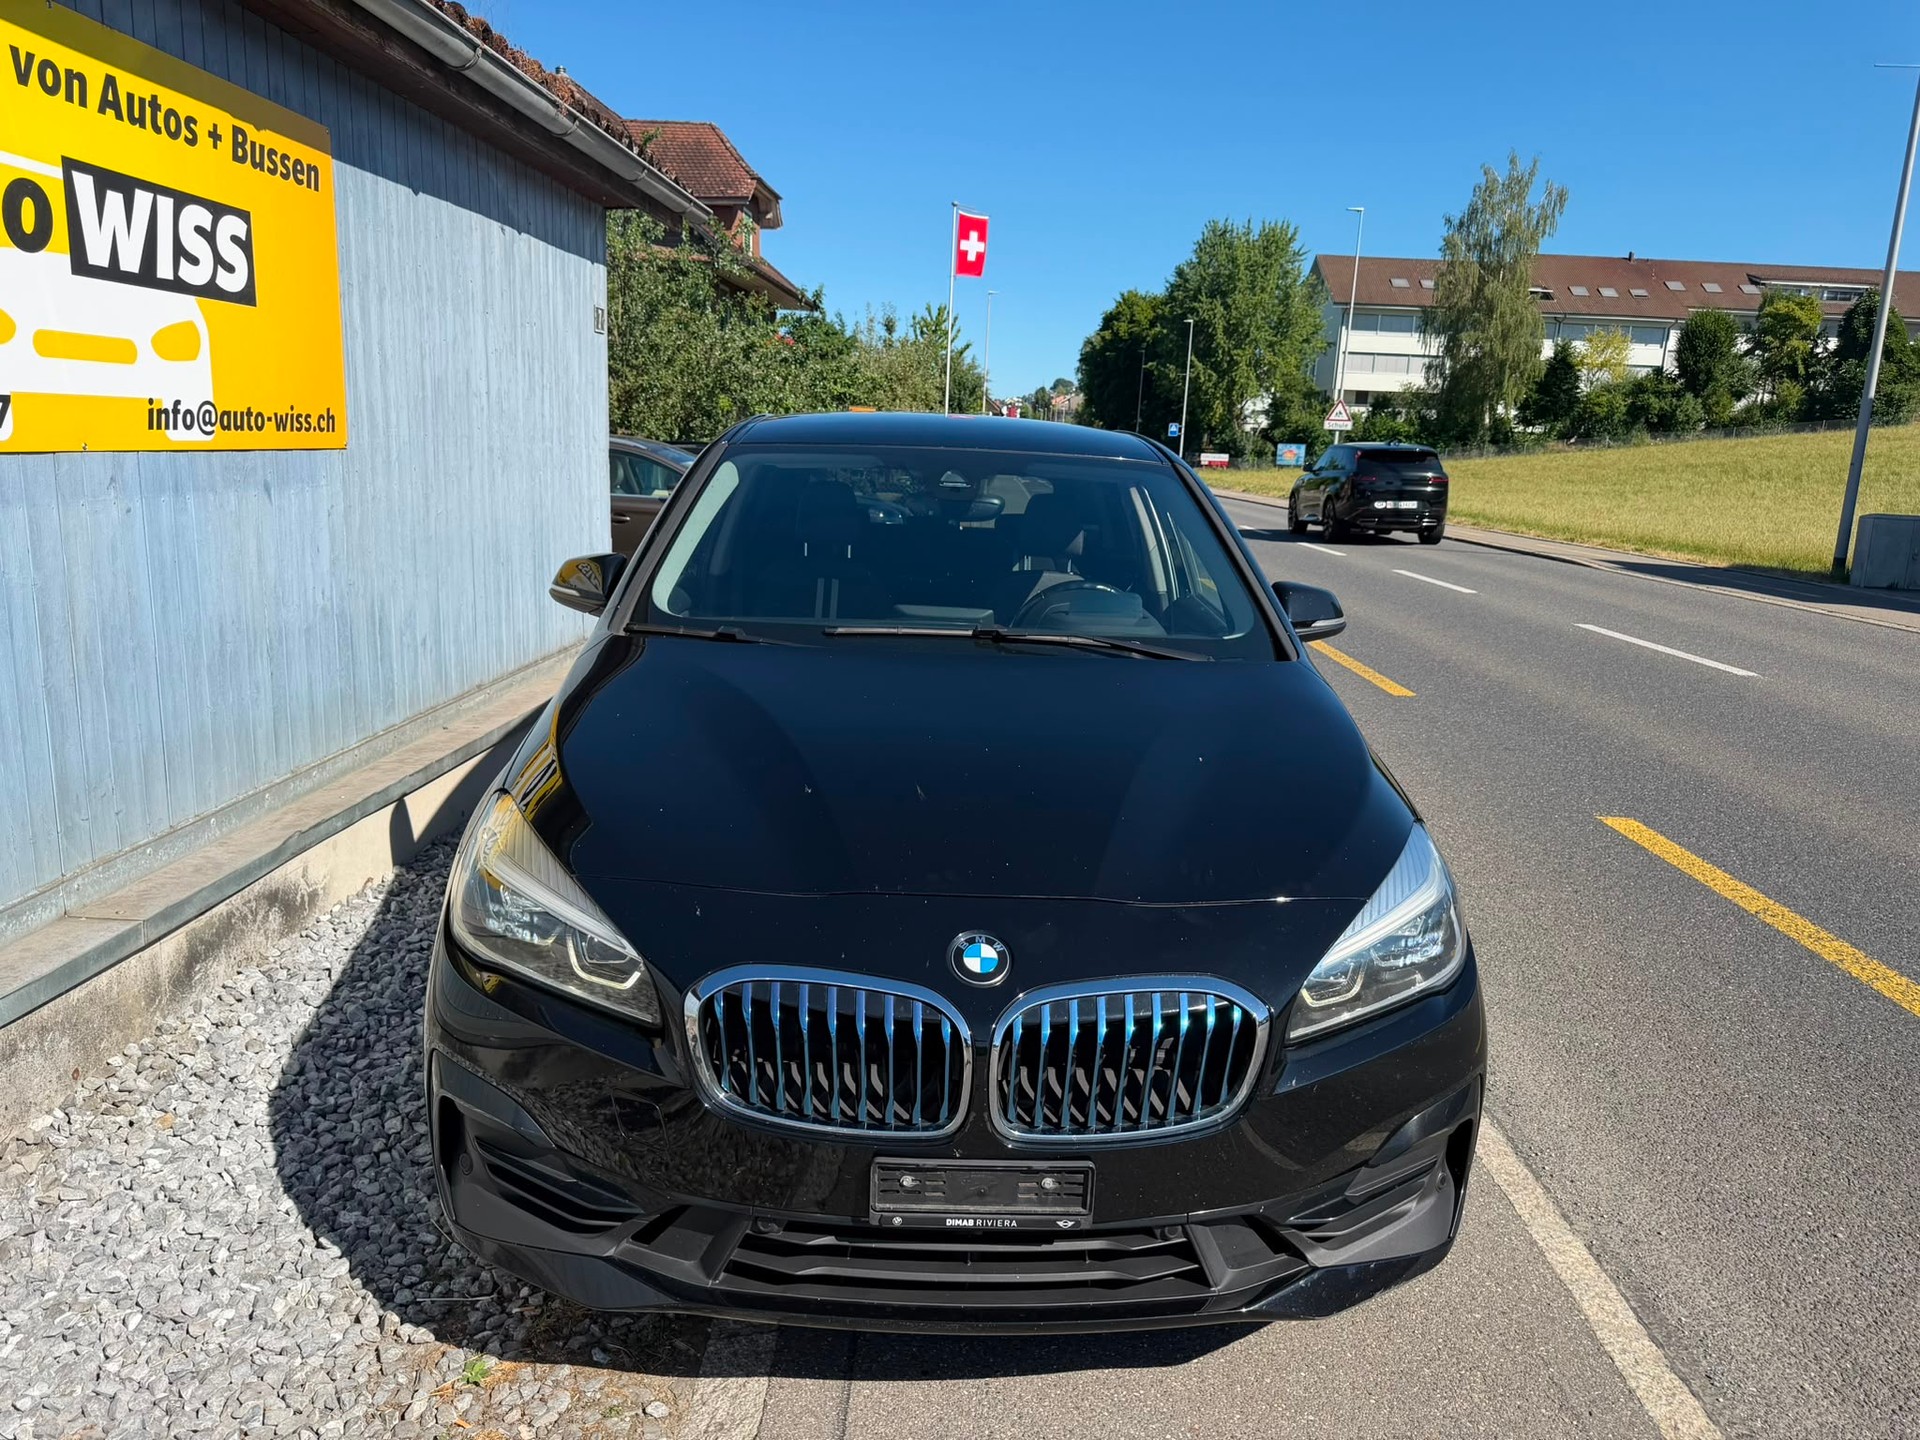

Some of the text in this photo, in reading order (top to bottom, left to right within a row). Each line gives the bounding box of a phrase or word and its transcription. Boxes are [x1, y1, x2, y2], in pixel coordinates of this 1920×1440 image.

[8, 44, 321, 192] von Autos + Bussen
[71, 170, 250, 293] WISS
[147, 397, 337, 436] info@auto-wiss.ch
[958, 935, 1005, 951] BMW
[945, 1218, 1018, 1228] DIMAB RIVIERA
